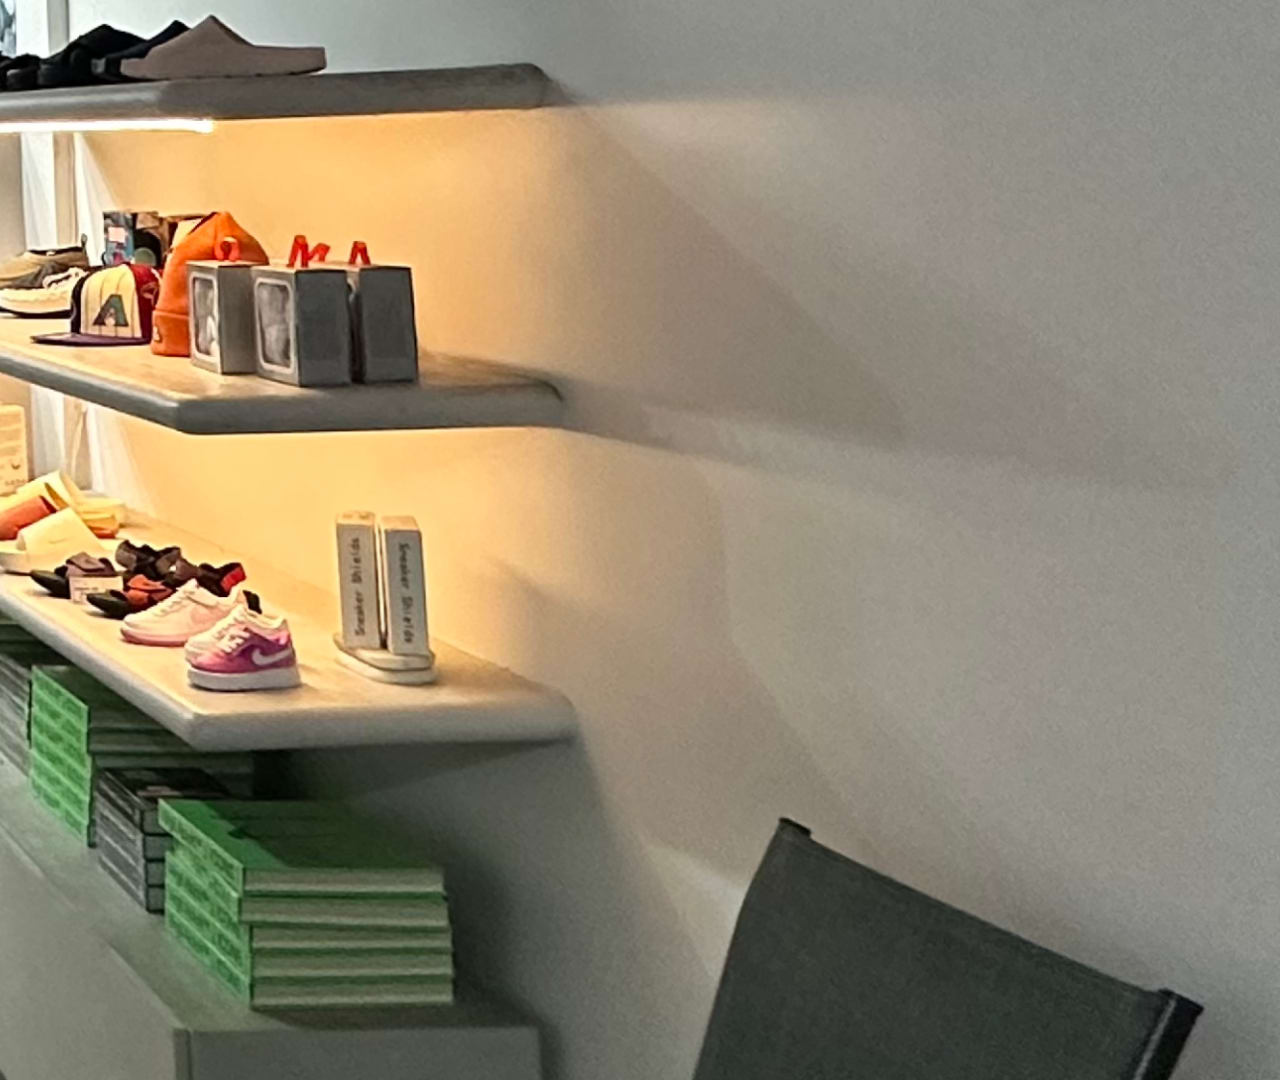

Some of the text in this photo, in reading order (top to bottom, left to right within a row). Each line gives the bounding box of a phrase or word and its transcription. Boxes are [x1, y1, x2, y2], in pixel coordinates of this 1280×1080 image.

[349, 537, 366, 636] Sneaker Shields
[399, 542, 416, 643] Sneaker Shields
